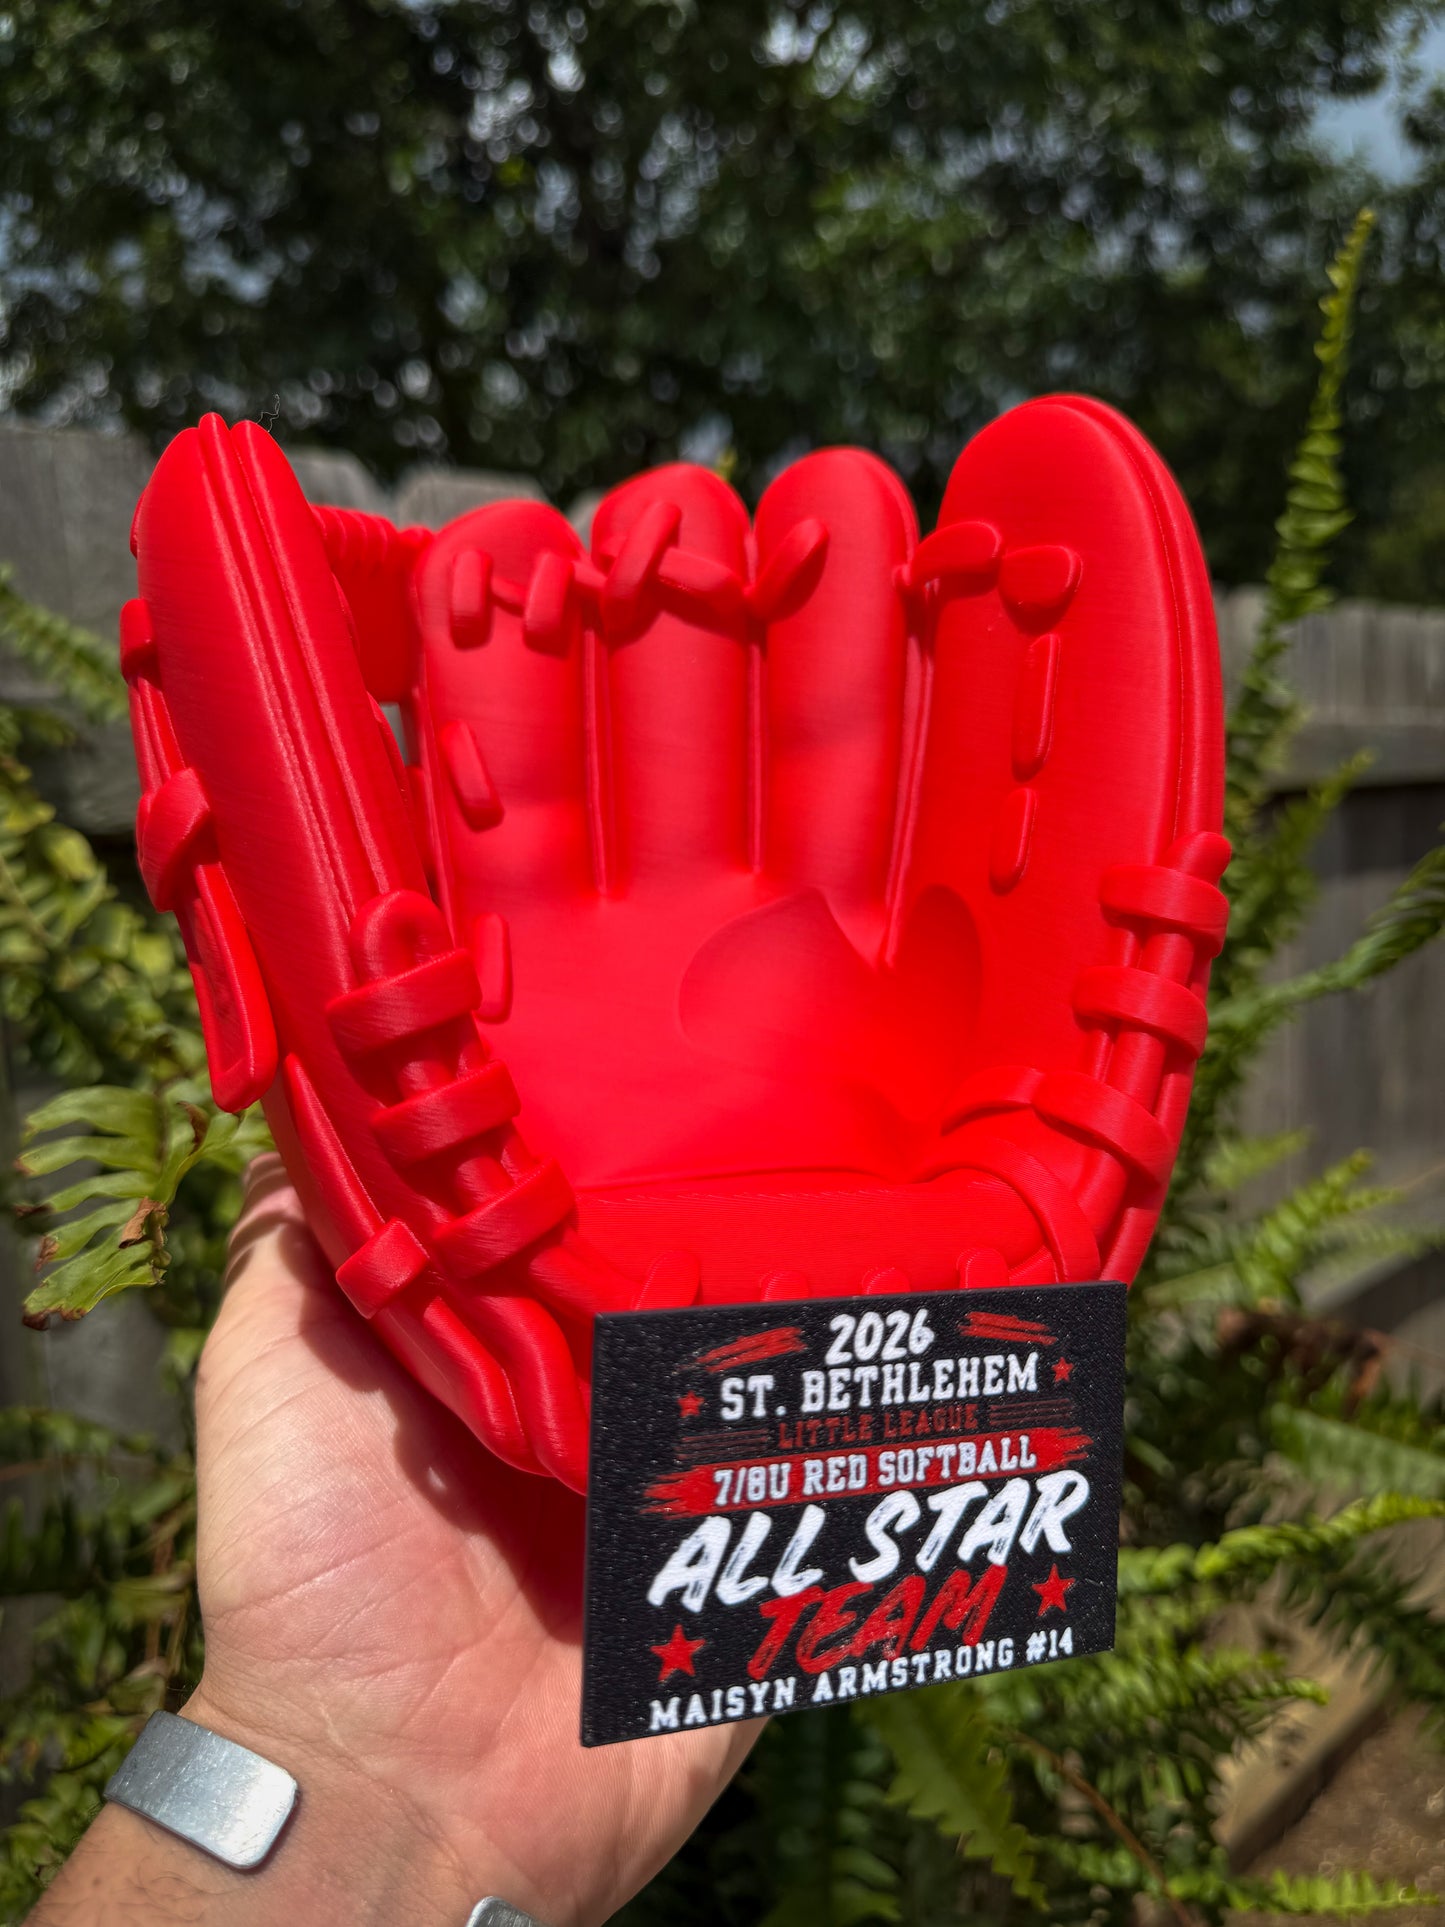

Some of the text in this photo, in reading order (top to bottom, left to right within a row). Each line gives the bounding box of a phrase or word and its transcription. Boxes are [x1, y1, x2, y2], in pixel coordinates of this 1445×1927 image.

[825, 1309, 935, 1366] 2026
[720, 1352, 1038, 1421] ST. BETHLEHEM
[777, 1403, 979, 1449] LITTLE LEAGUE
[713, 1435, 1037, 1506] 7/8U RED SOFTBALL
[647, 1469, 1090, 1613] ALL STAR
[747, 1564, 1008, 1681] TEAM
[649, 1626, 1075, 1732] MAISYN ARMSTRONG #14
